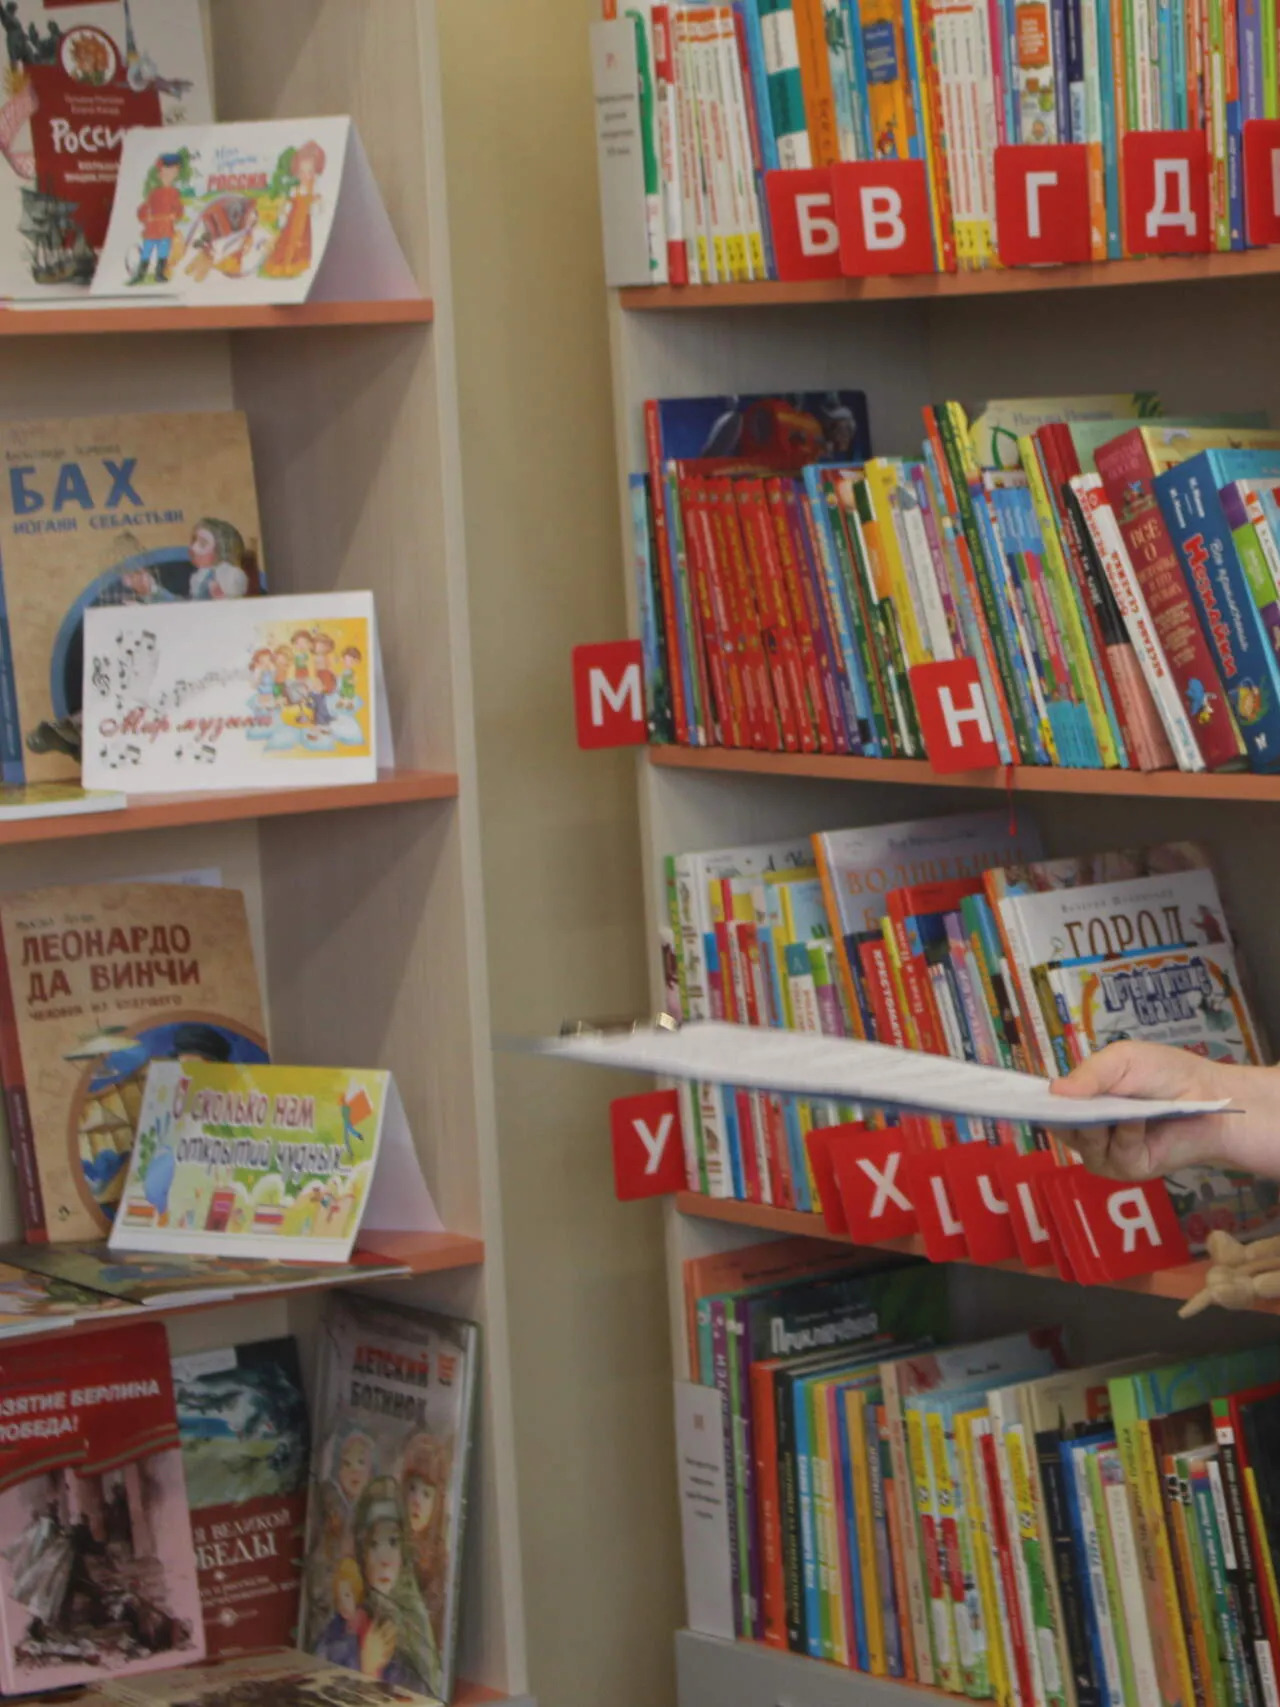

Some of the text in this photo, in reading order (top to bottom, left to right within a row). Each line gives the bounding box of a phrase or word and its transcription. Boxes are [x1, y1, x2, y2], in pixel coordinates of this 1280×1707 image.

[49, 118, 126, 153] Росси
[794, 193, 839, 256] Б
[859, 186, 906, 251] В
[1025, 171, 1057, 238] Г
[1146, 158, 1197, 237] Д
[9, 457, 144, 515] БАХ
[89, 510, 184, 531] СЕБАСТЬЯН
[588, 664, 642, 727] М
[938, 684, 993, 747] Н
[21, 924, 192, 966] ЛЕОНАРДО
[1064, 904, 1184, 958] ГОРОД
[28, 959, 200, 1004] ДА ВИНЧИ
[191, 1090, 268, 1126] сколько
[273, 1095, 315, 1131] нам
[632, 1113, 674, 1175] У
[856, 1152, 914, 1218] Х
[1106, 1186, 1162, 1253] Я
[0, 1379, 160, 1416] ЗЯТИЕ БЕРЛИНА
[197, 1531, 280, 1571] БЕДЫ
